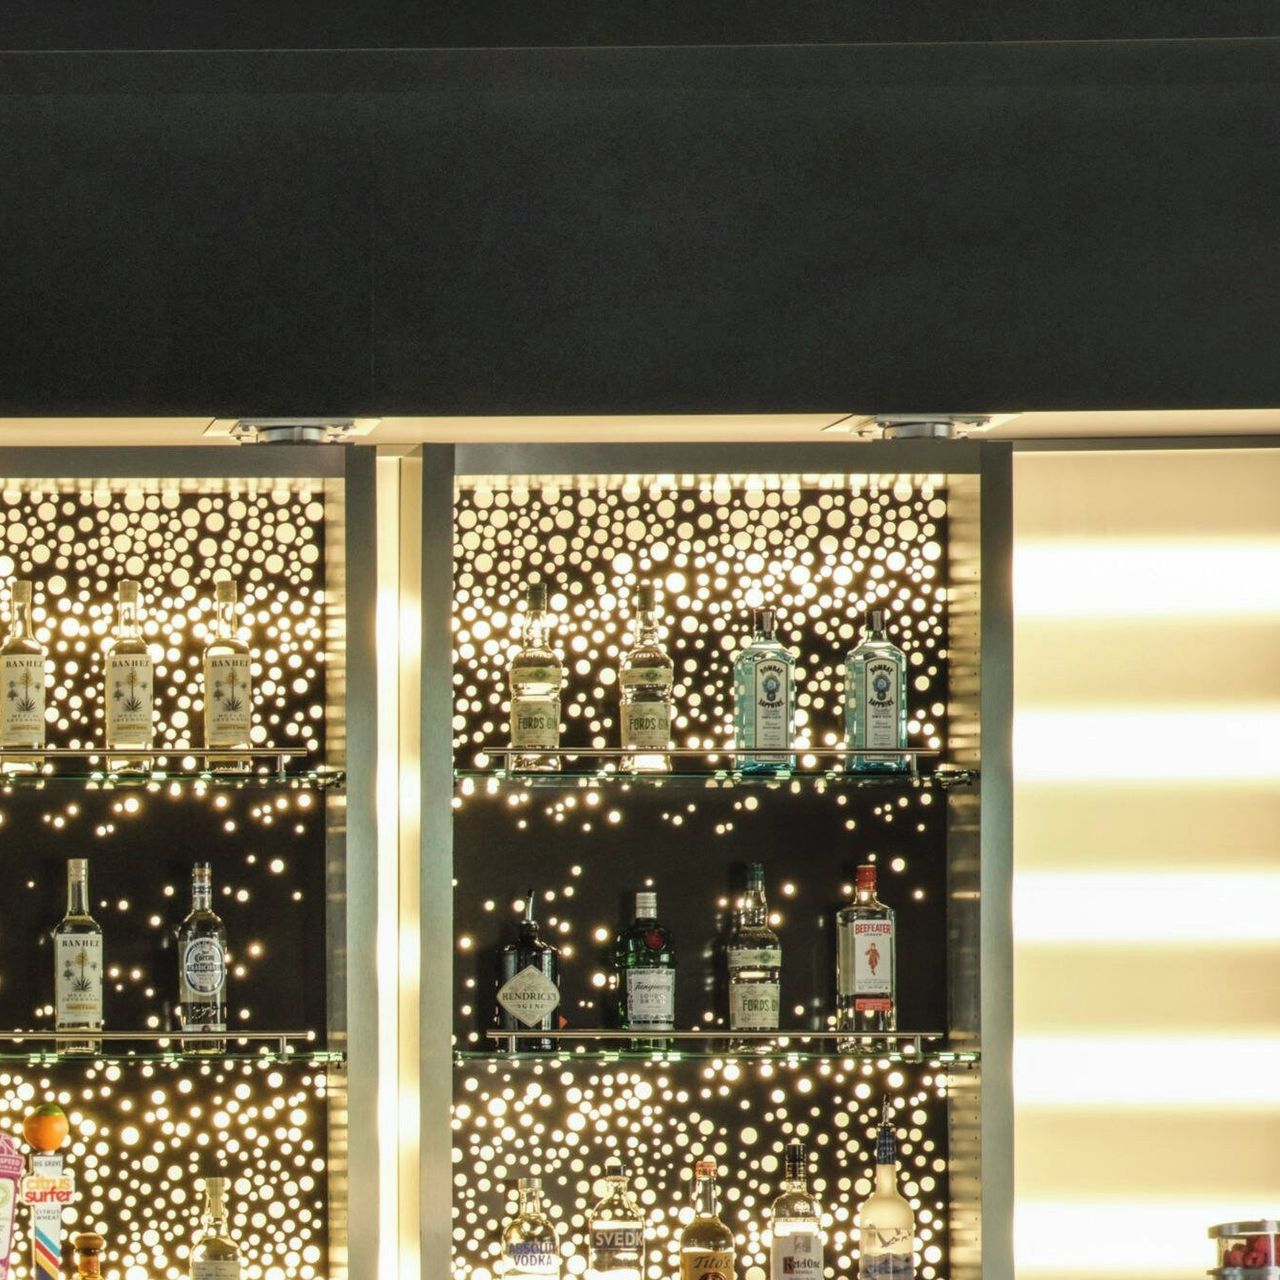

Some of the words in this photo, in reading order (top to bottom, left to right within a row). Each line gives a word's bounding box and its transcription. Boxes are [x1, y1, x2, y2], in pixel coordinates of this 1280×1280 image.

[518, 717, 544, 731] FORDS
[630, 717, 656, 731] FORDS
[855, 923, 891, 936] BEEFEATER
[743, 998, 769, 1012] FORDS
[27, 1174, 71, 1191] citrus
[25, 1186, 73, 1203] surfer
[510, 1241, 556, 1256] ABSOLUT
[513, 1253, 553, 1267] VODKA
[694, 1255, 732, 1269] Tito's
